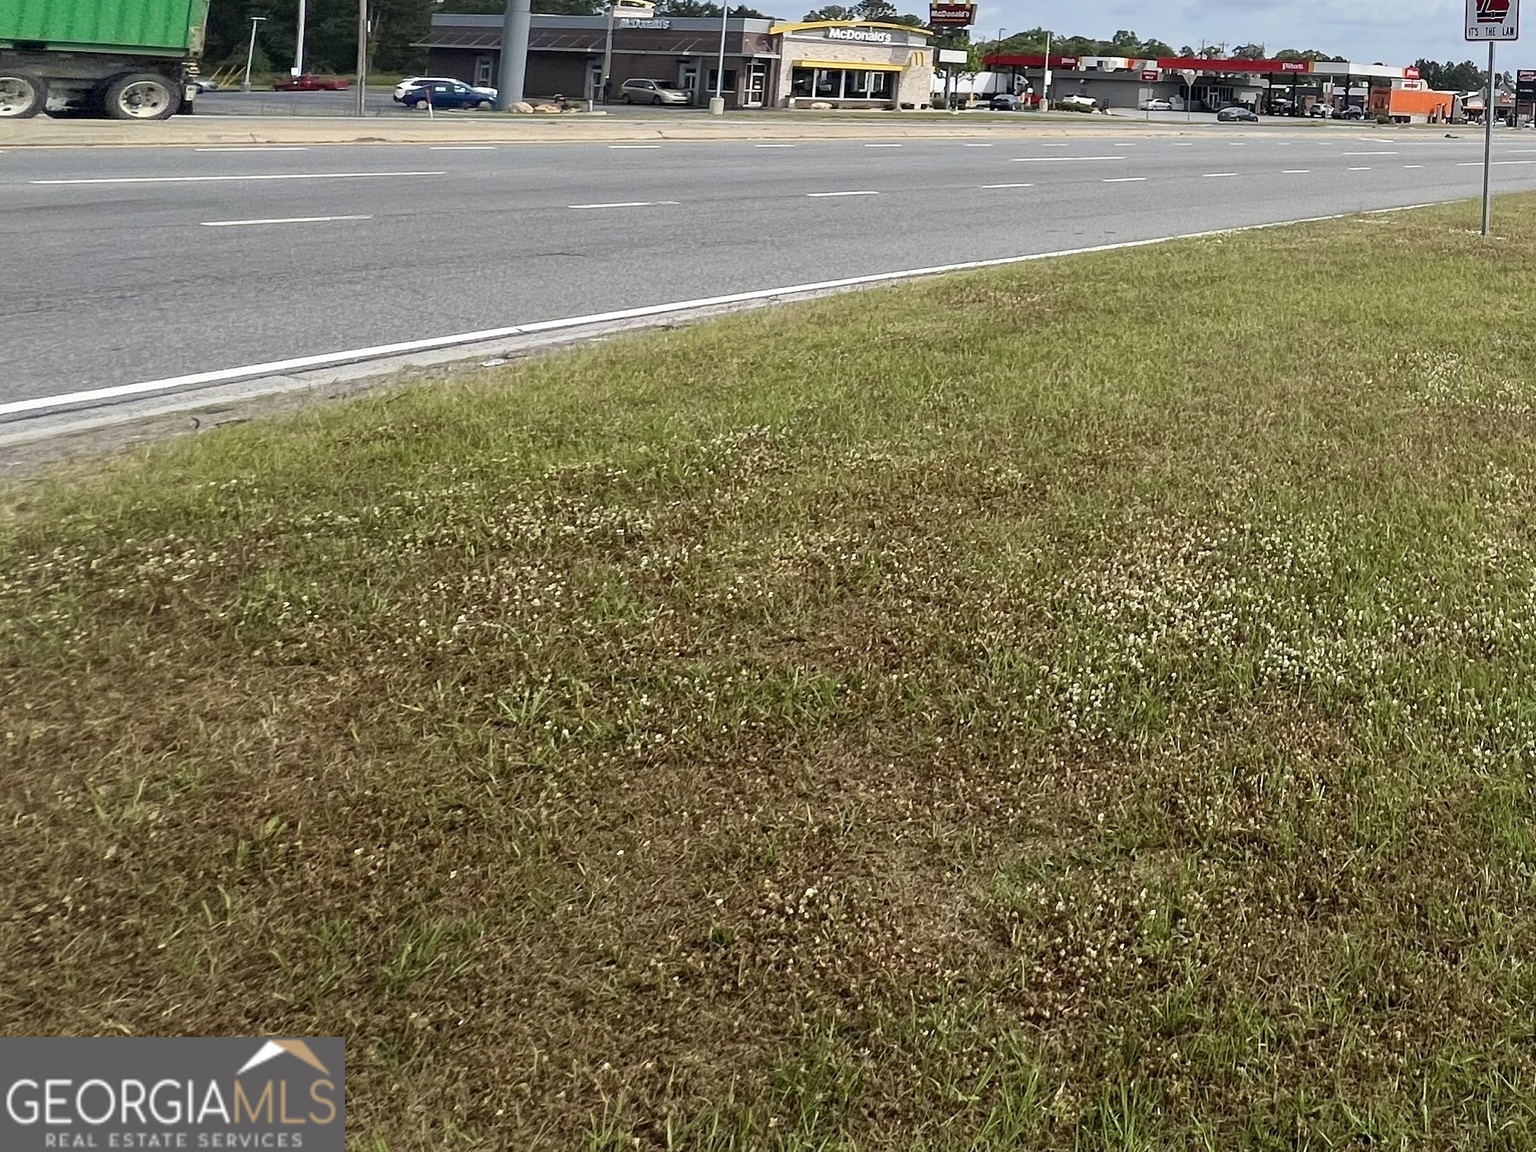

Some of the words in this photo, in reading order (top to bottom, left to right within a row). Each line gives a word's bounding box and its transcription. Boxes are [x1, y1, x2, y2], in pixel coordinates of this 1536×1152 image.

[930, 9, 970, 18] McDonald's
[828, 27, 893, 44] McDonald's
[1485, 27, 1496, 37] THE
[1502, 27, 1515, 36] LAW
